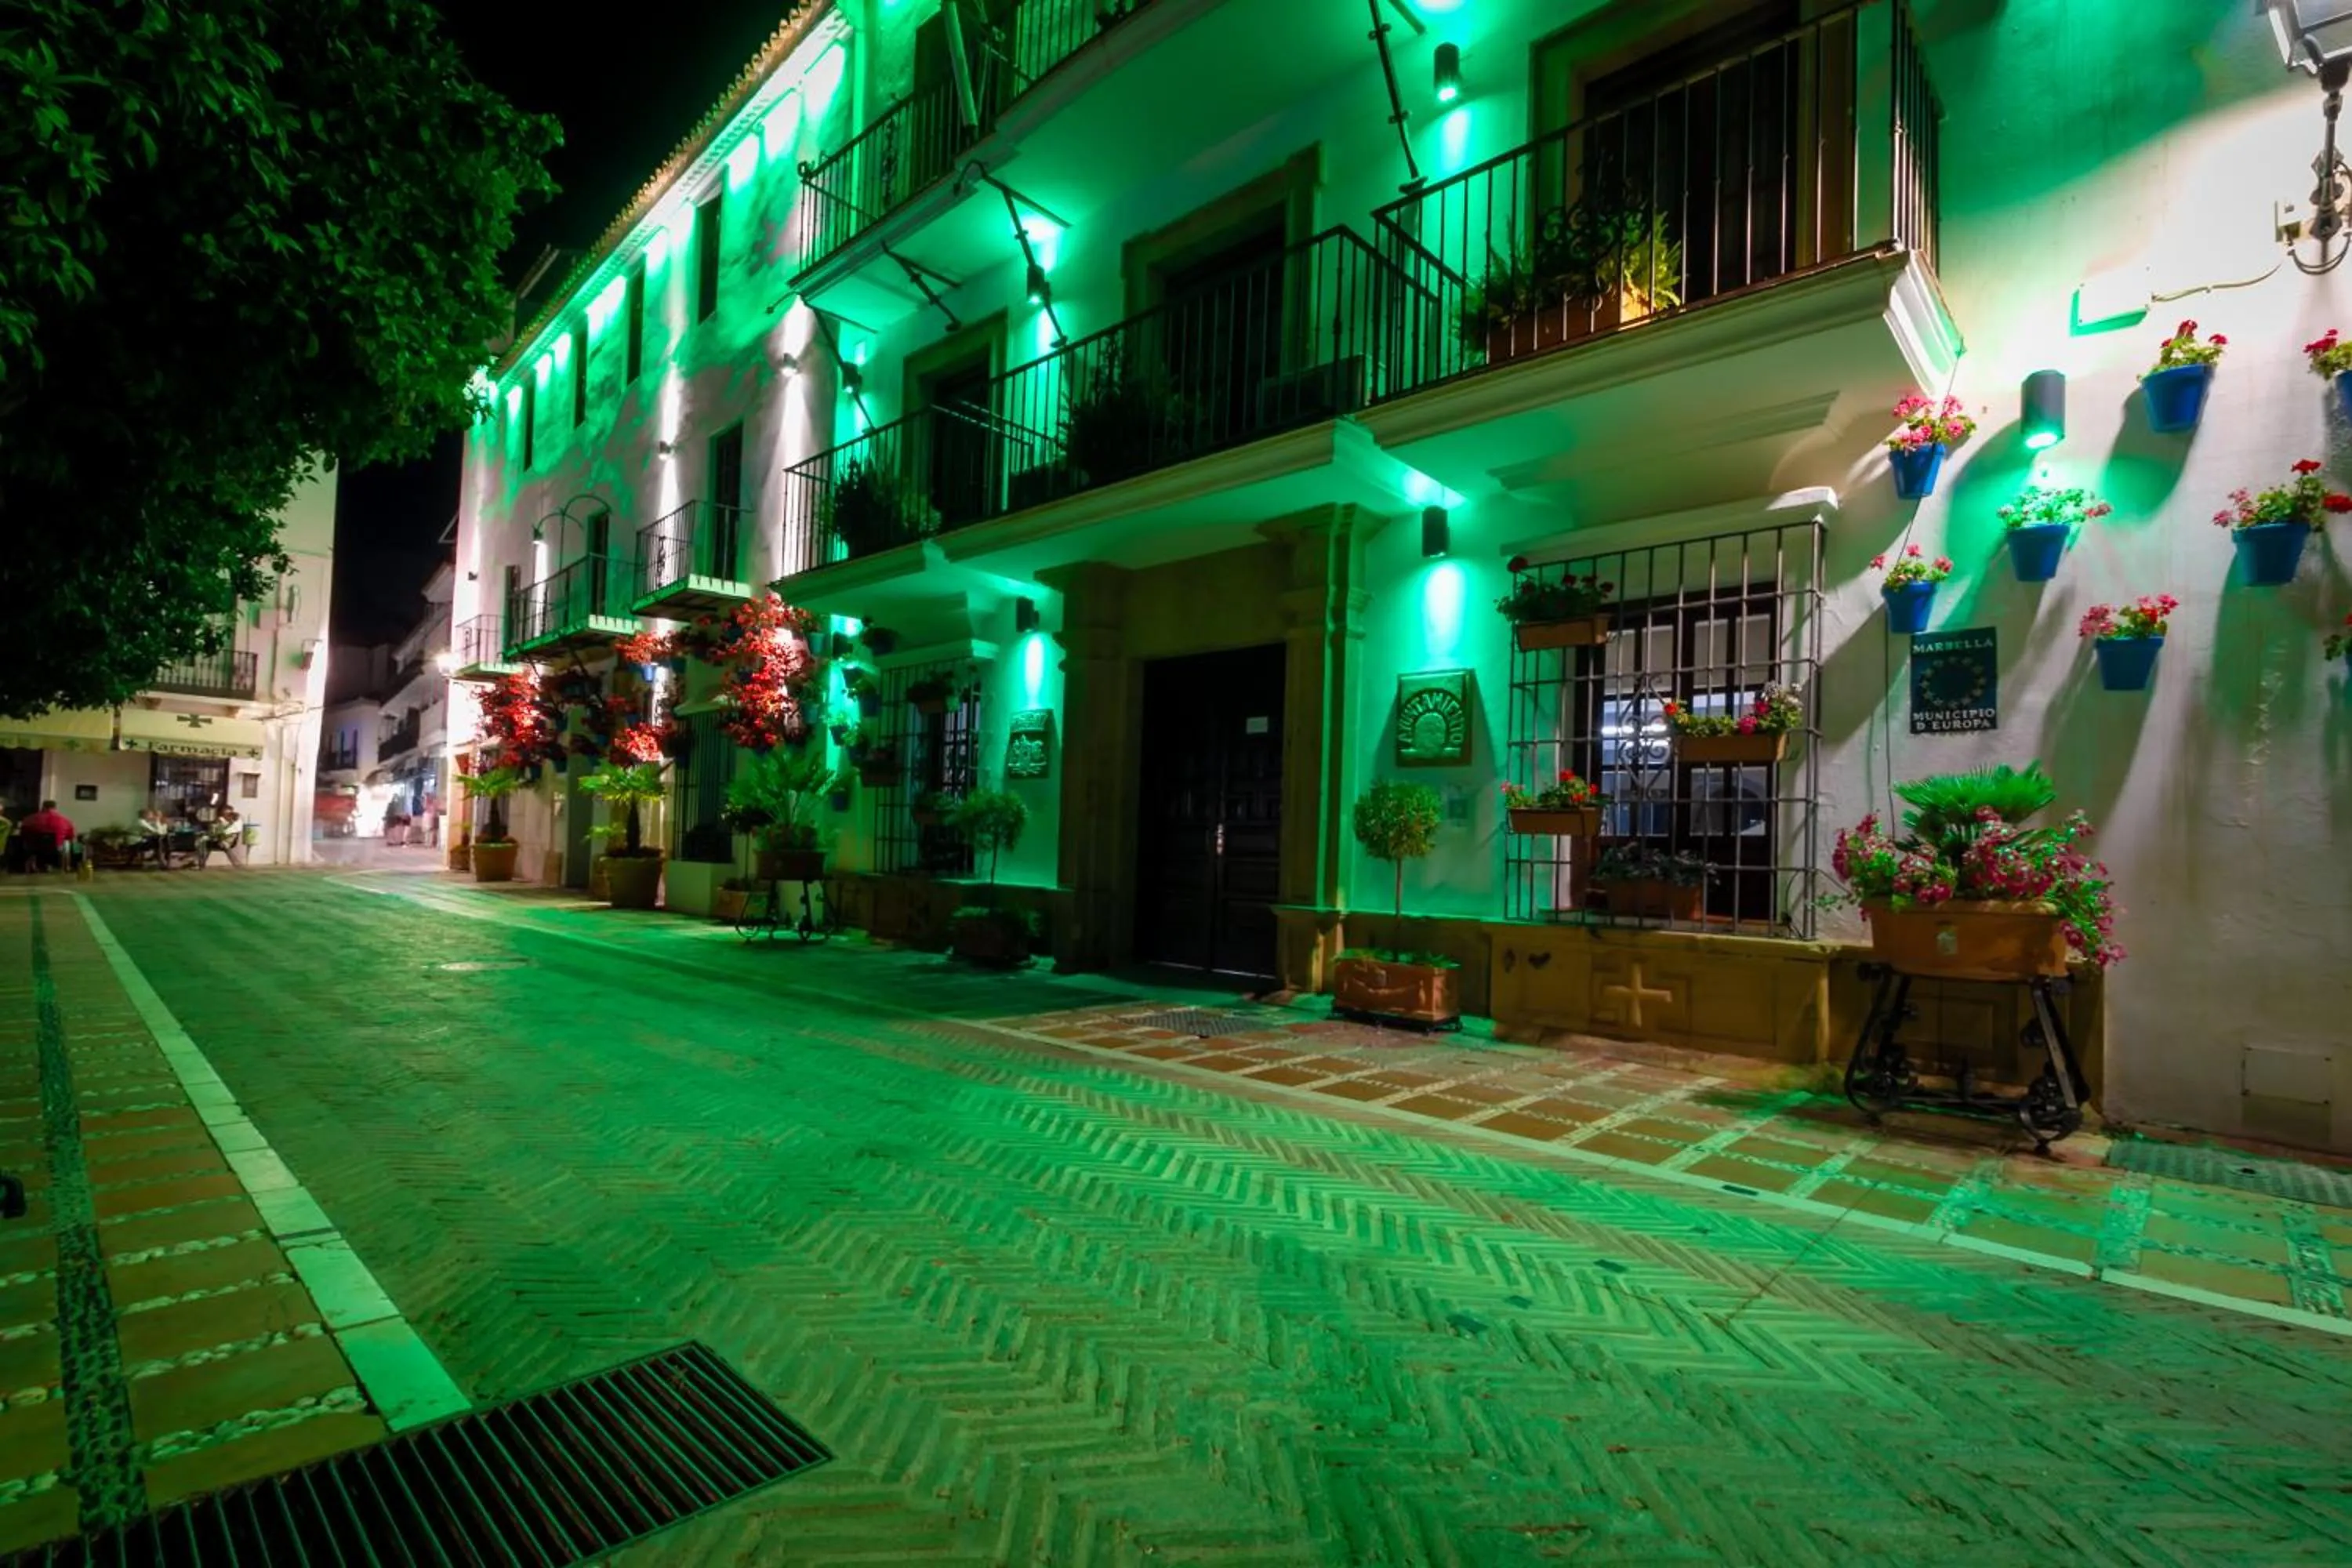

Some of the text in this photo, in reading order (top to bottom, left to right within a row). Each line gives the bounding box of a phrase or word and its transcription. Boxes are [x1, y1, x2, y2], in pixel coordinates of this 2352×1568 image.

[1912, 637, 1994, 654] MARBELLA
[1913, 708, 1995, 720] MUNICIPIO
[148, 742, 238, 757] Farmacia
